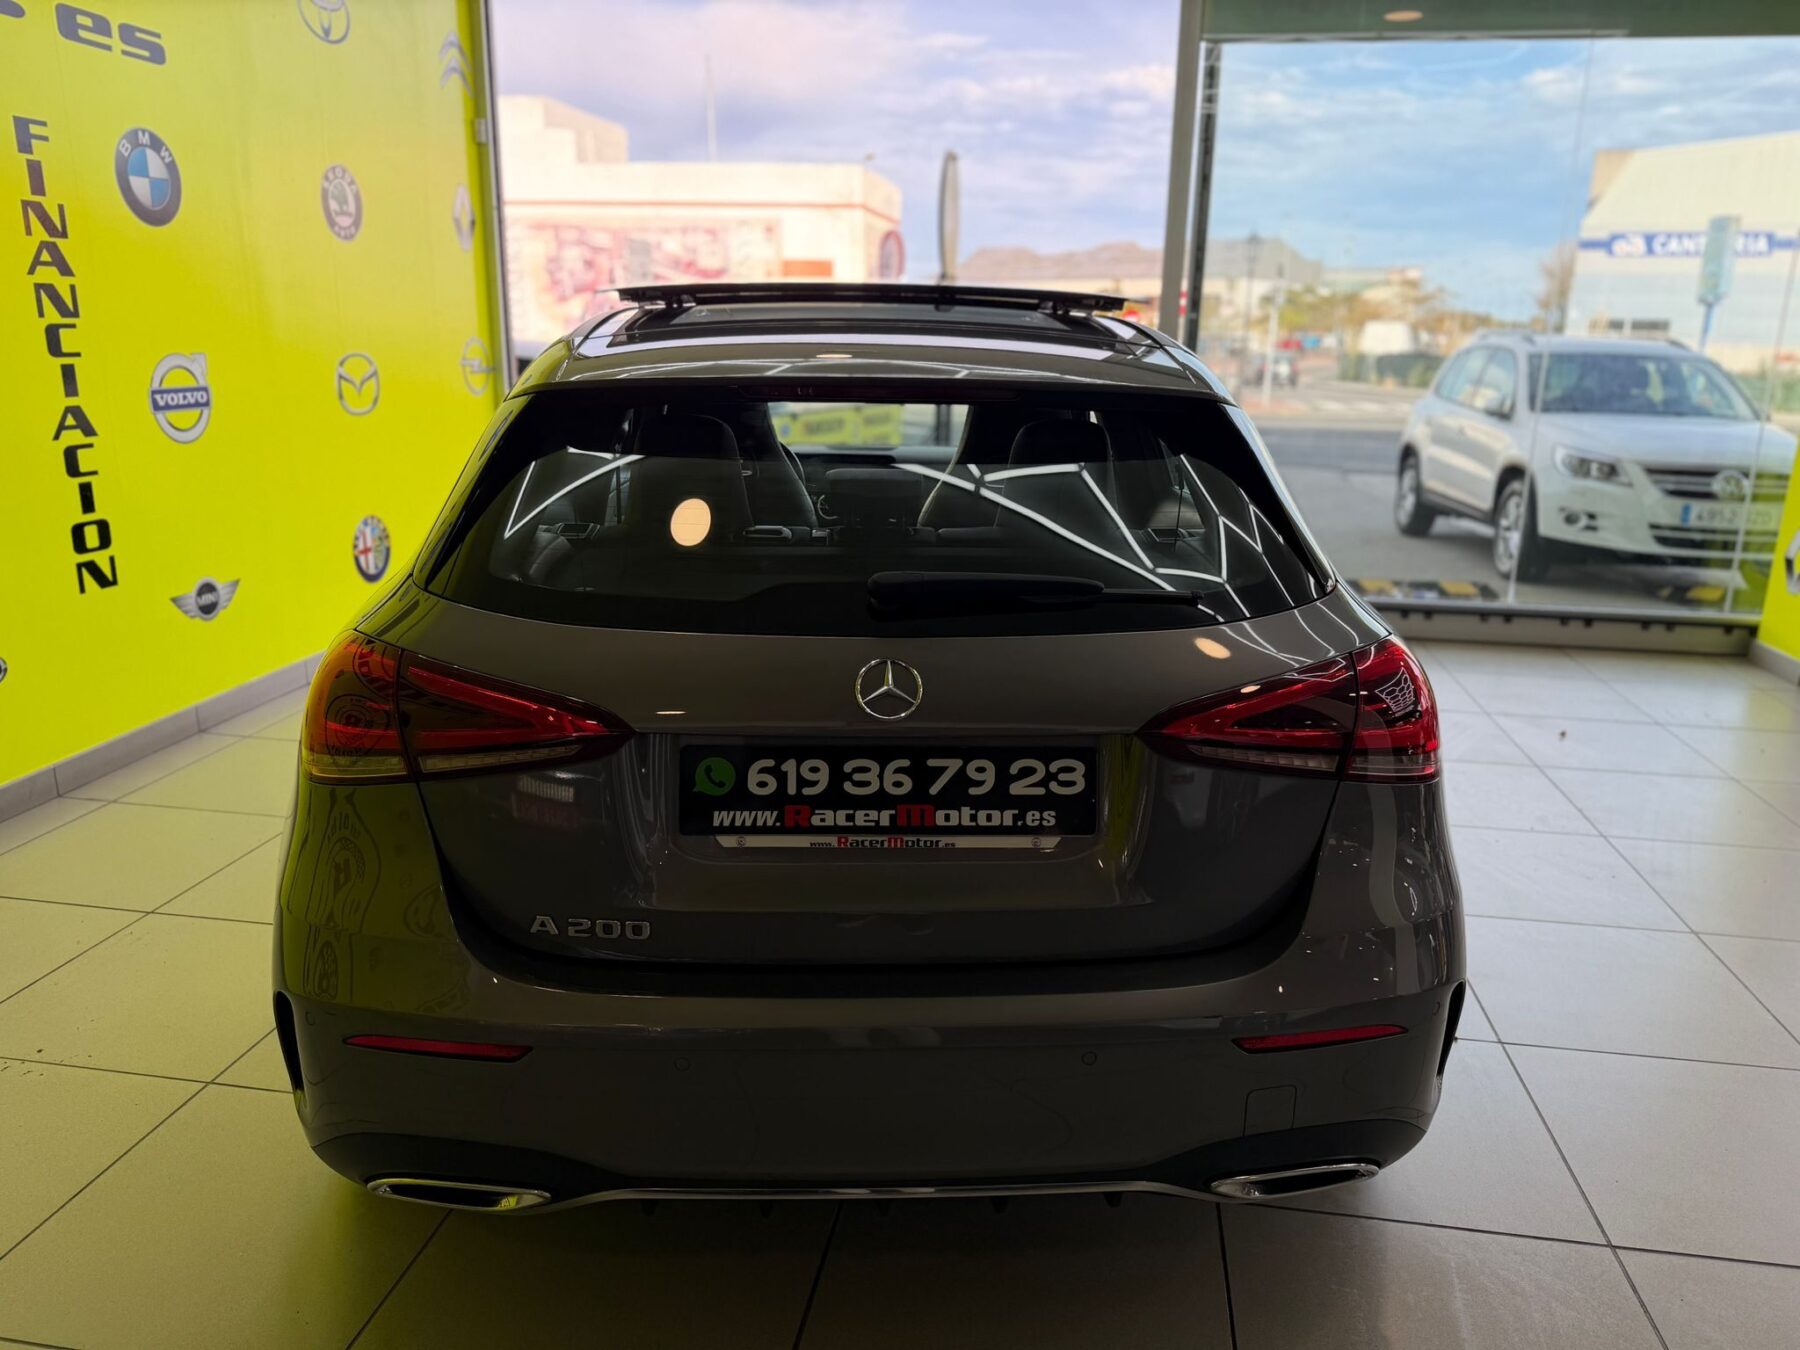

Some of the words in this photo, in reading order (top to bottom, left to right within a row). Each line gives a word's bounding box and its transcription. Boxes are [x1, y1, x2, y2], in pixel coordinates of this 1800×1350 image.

[119, 129, 172, 163] BMW
[12, 115, 118, 594] FINANCIACION
[153, 391, 208, 406] VOLVO
[747, 758, 830, 796] 619
[843, 758, 914, 796] 36
[927, 758, 996, 796] 79
[1008, 758, 1087, 796] 23
[712, 804, 1057, 828] www.RacerMotor.es
[809, 836, 956, 849] www.RacerMotor.es
[529, 915, 559, 936] A
[567, 918, 651, 940] 200
